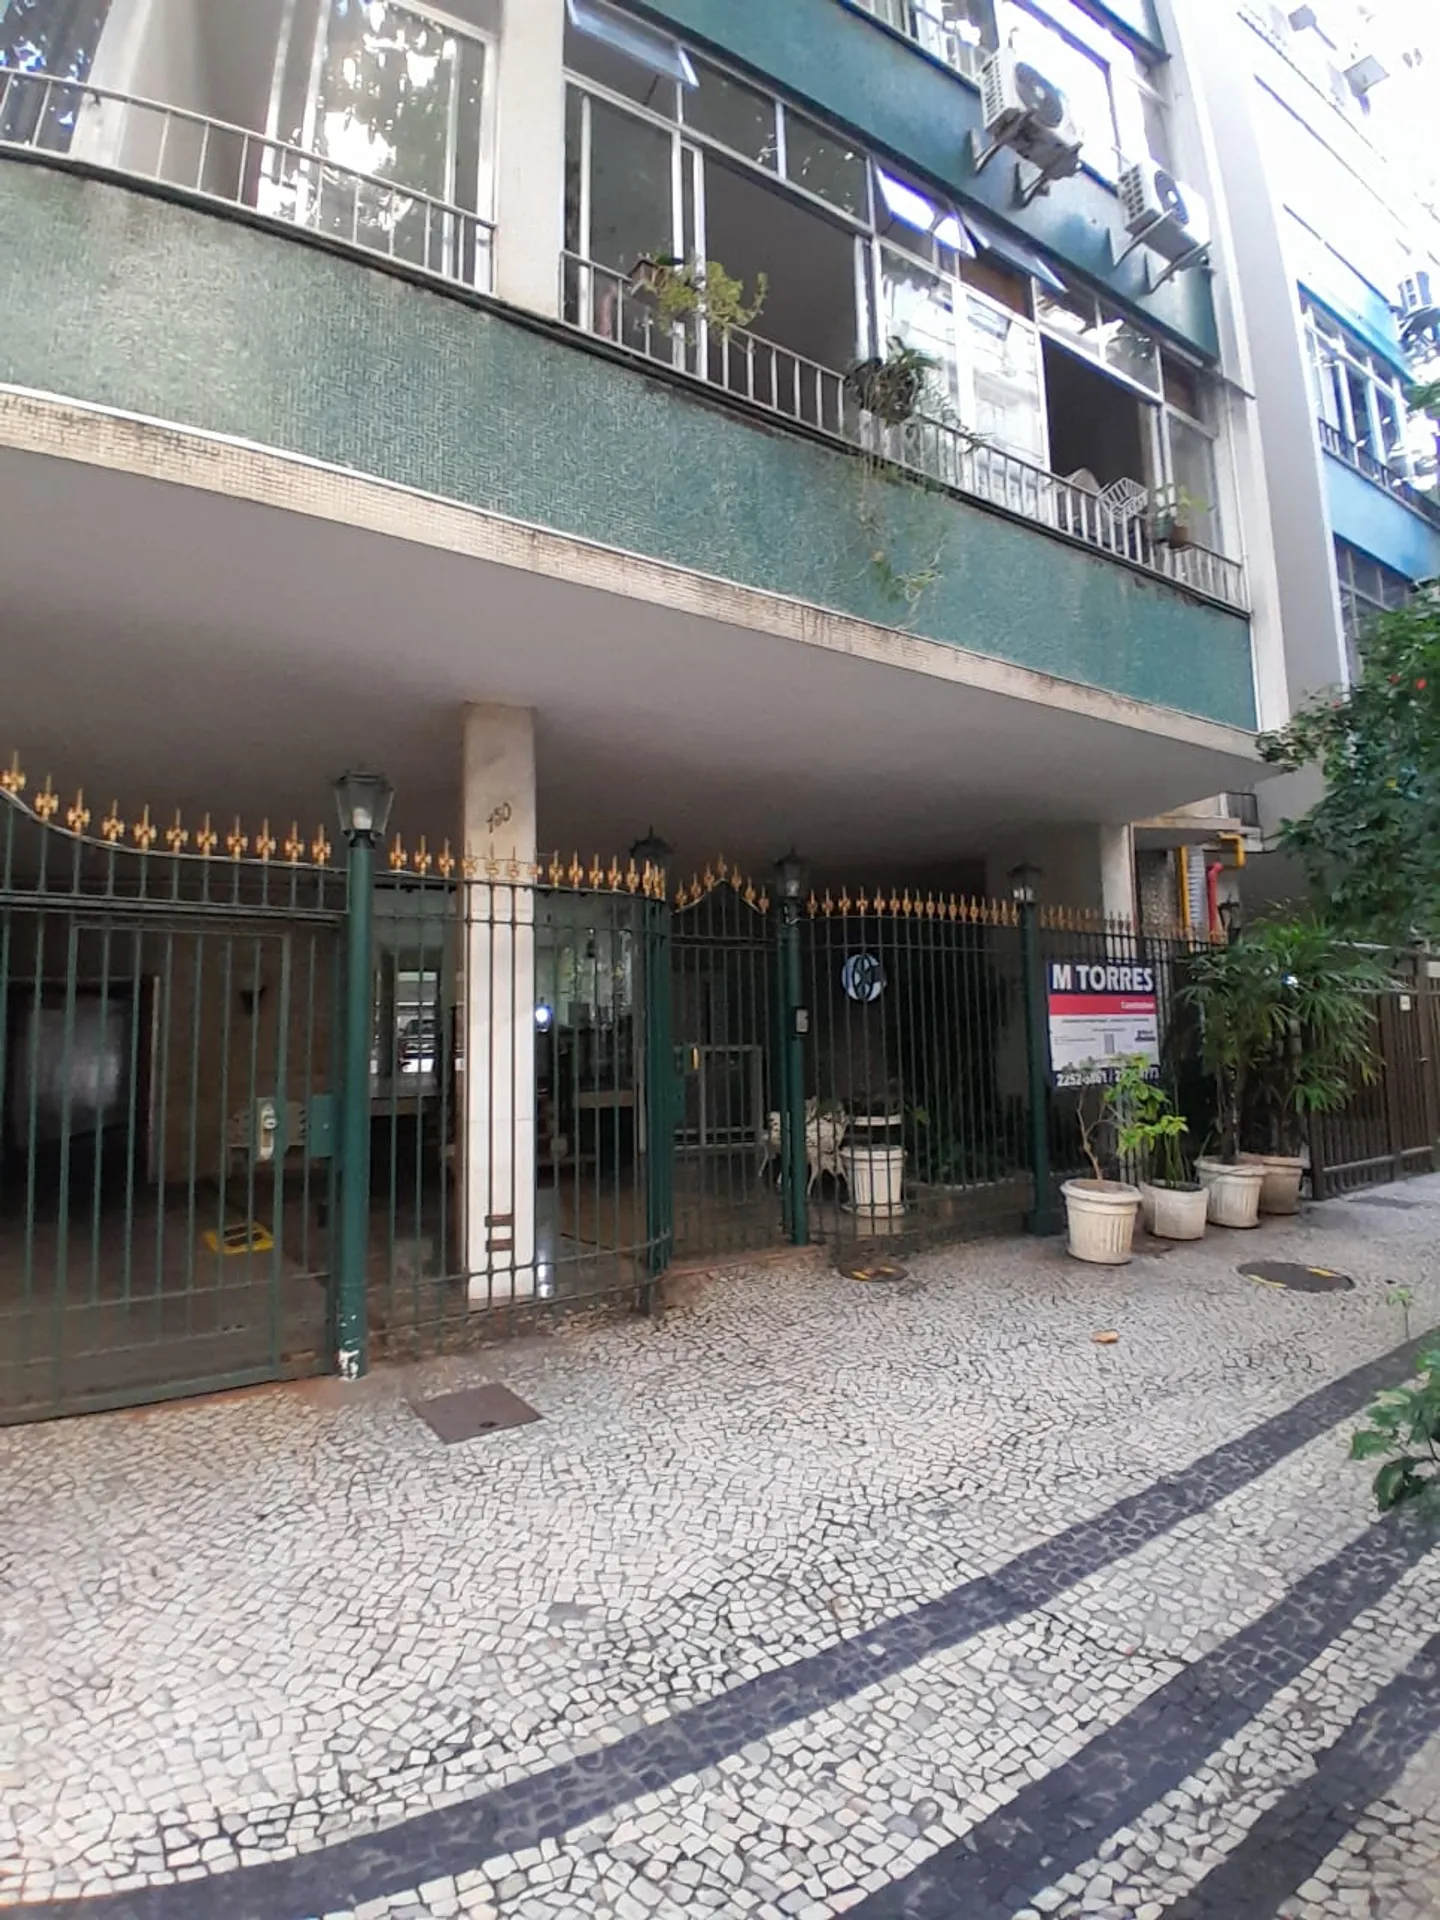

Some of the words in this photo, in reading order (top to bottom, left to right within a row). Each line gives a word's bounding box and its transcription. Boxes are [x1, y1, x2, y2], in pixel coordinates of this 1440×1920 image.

[486, 801, 512, 834] 150
[1052, 964, 1072, 990] M
[1075, 965, 1153, 992] TORRES
